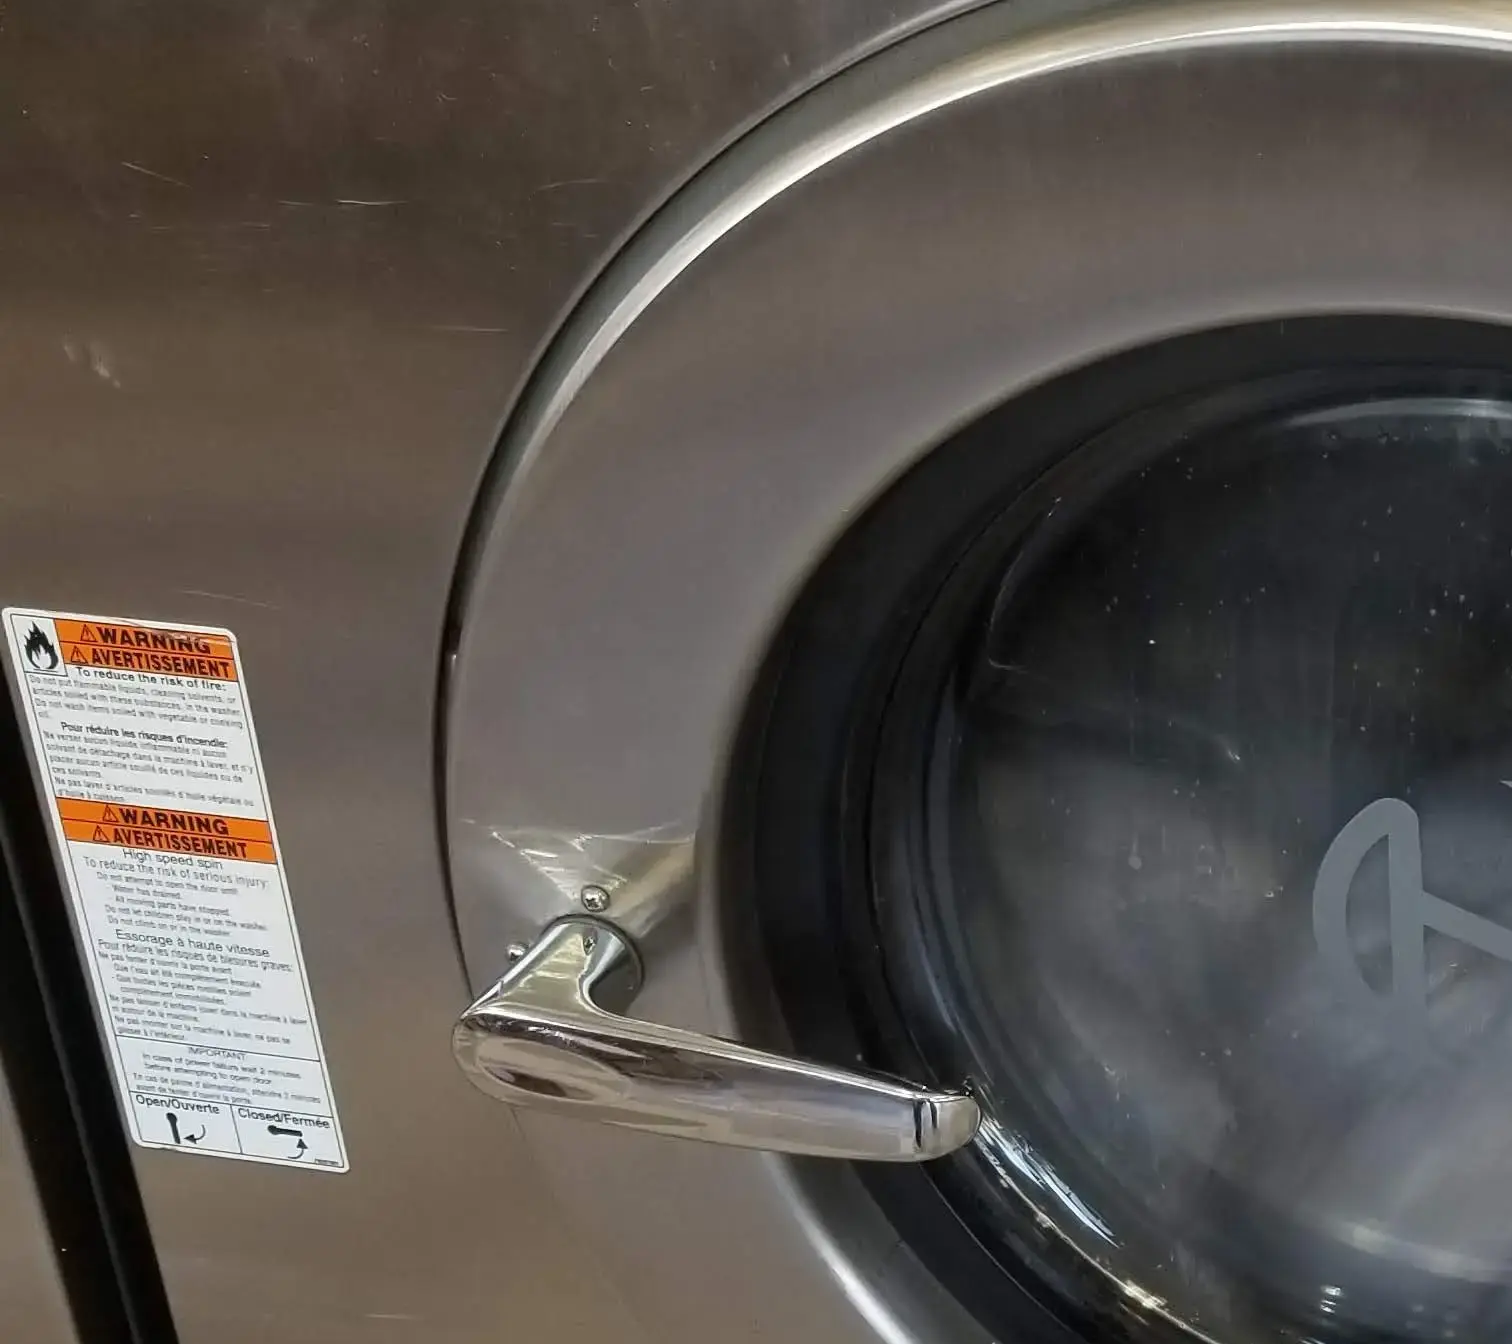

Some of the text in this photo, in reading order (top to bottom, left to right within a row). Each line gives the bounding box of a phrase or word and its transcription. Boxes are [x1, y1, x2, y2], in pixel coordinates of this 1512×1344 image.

[96, 627, 210, 654] WARNING
[91, 648, 229, 679] AVERTISSEMENT
[76, 667, 90, 677] To
[94, 670, 135, 682] reduce
[138, 672, 157, 684] the
[160, 677, 183, 687] risk
[188, 679, 198, 688] of
[61, 722, 83, 733] Pour
[119, 808, 229, 835] WARNING
[113, 828, 247, 858] AVERTISSEMENT
[85, 856, 96, 867] To
[100, 860, 135, 872] reduce
[138, 863, 154, 874] the
[157, 866, 177, 877] risk
[123, 849, 223, 870] High speed spin
[116, 929, 173, 947] Essorage
[188, 938, 223, 951] haute
[226, 944, 270, 957] vitesse
[136, 1095, 220, 1114] Open/Ouverte
[238, 1108, 330, 1128] Closed/Fermée
